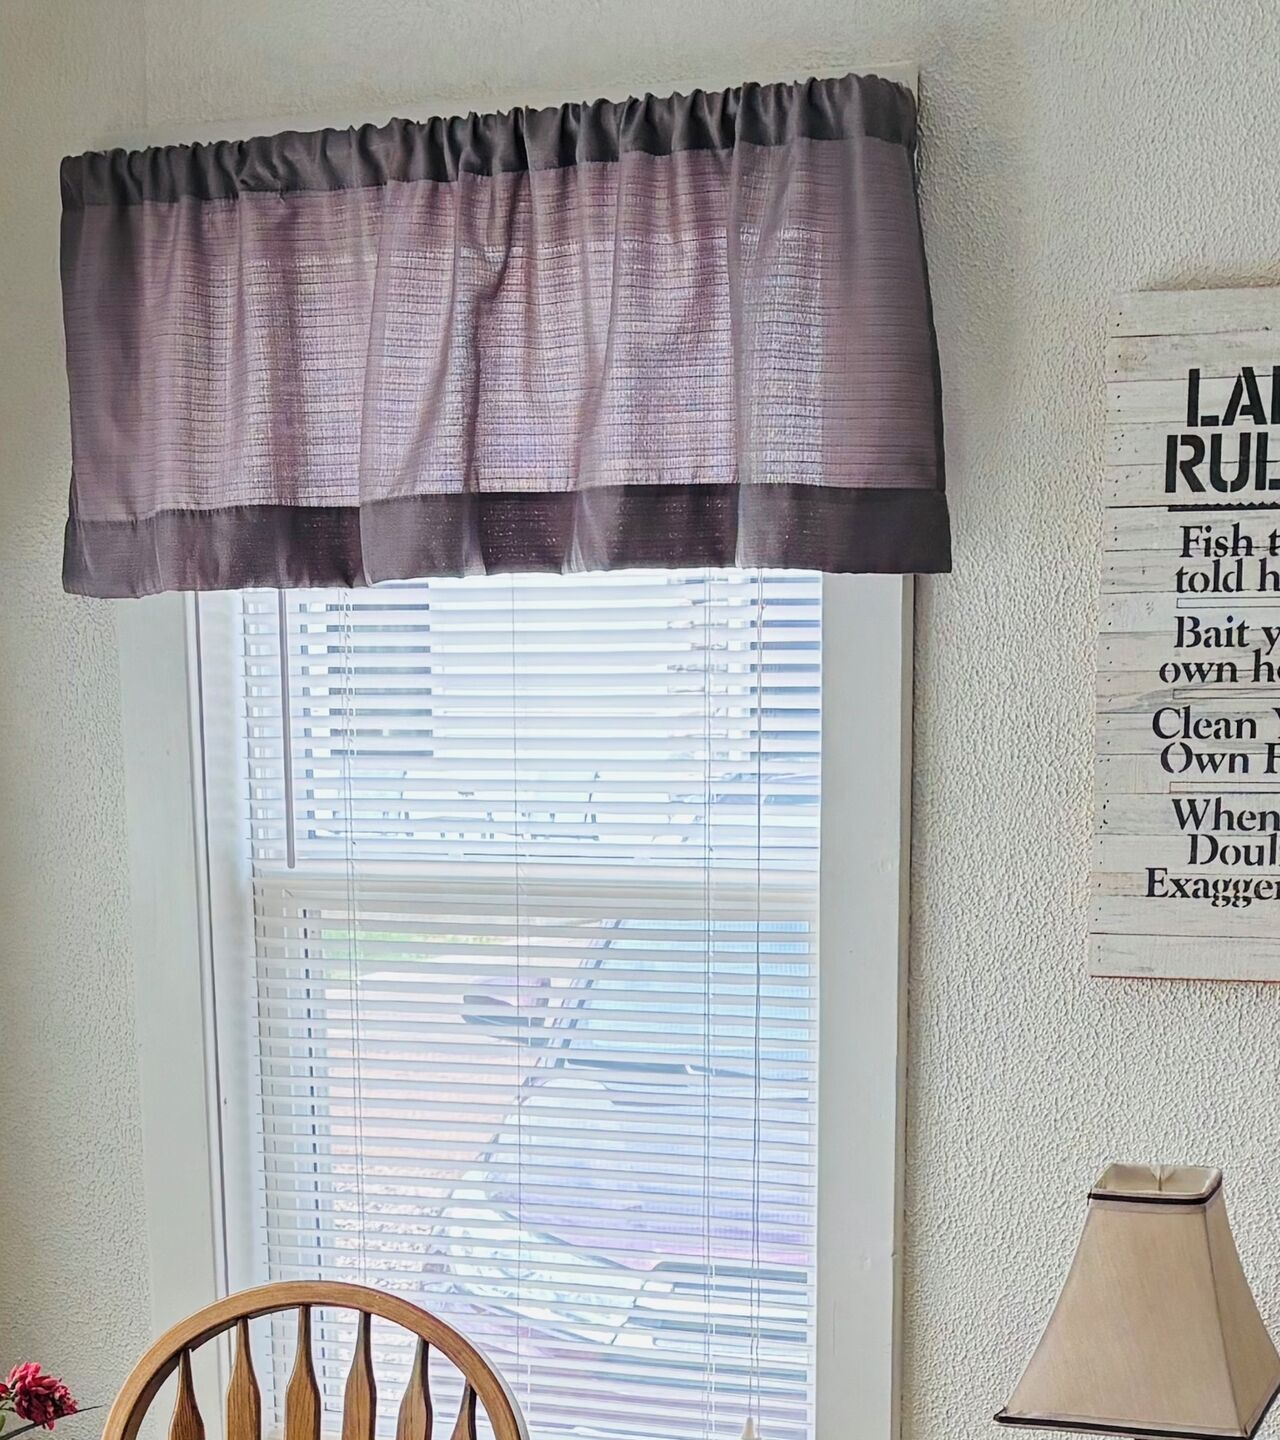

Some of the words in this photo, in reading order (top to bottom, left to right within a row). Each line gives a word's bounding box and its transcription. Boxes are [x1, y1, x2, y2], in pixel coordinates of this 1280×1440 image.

[1180, 522, 1253, 559] Fish
[1175, 559, 1245, 594] told
[1174, 615, 1249, 648] Bait
[1158, 660, 1238, 684] own
[1152, 705, 1257, 741] Clean
[1160, 742, 1248, 775] Own
[1171, 797, 1279, 833] When
